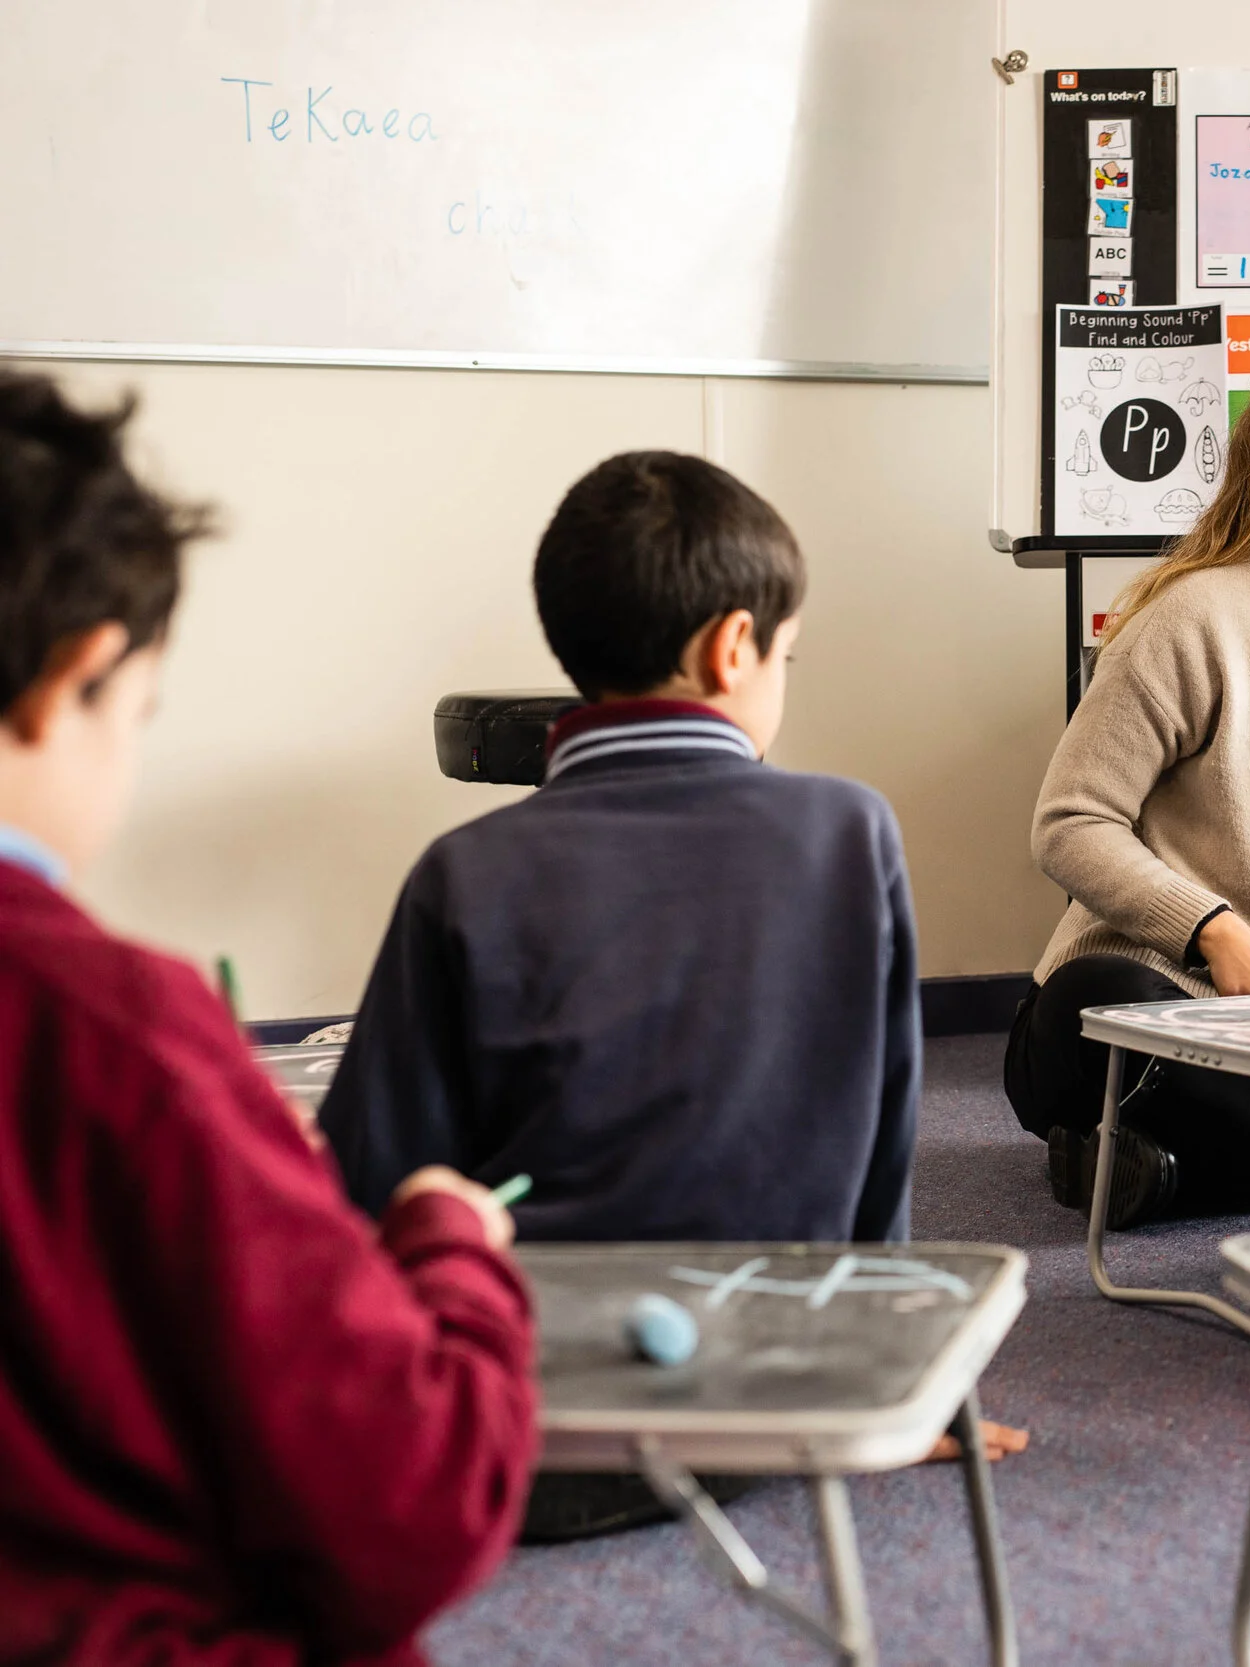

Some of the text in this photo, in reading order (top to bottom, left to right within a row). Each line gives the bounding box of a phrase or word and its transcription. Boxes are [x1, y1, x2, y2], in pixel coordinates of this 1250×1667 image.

[1050, 91, 1147, 102] What's on today?
[1095, 248, 1127, 260] ABC
[1069, 312, 1138, 328] Beginning
[1143, 312, 1183, 327] Sound
[1088, 331, 1195, 346] Find and Colour
